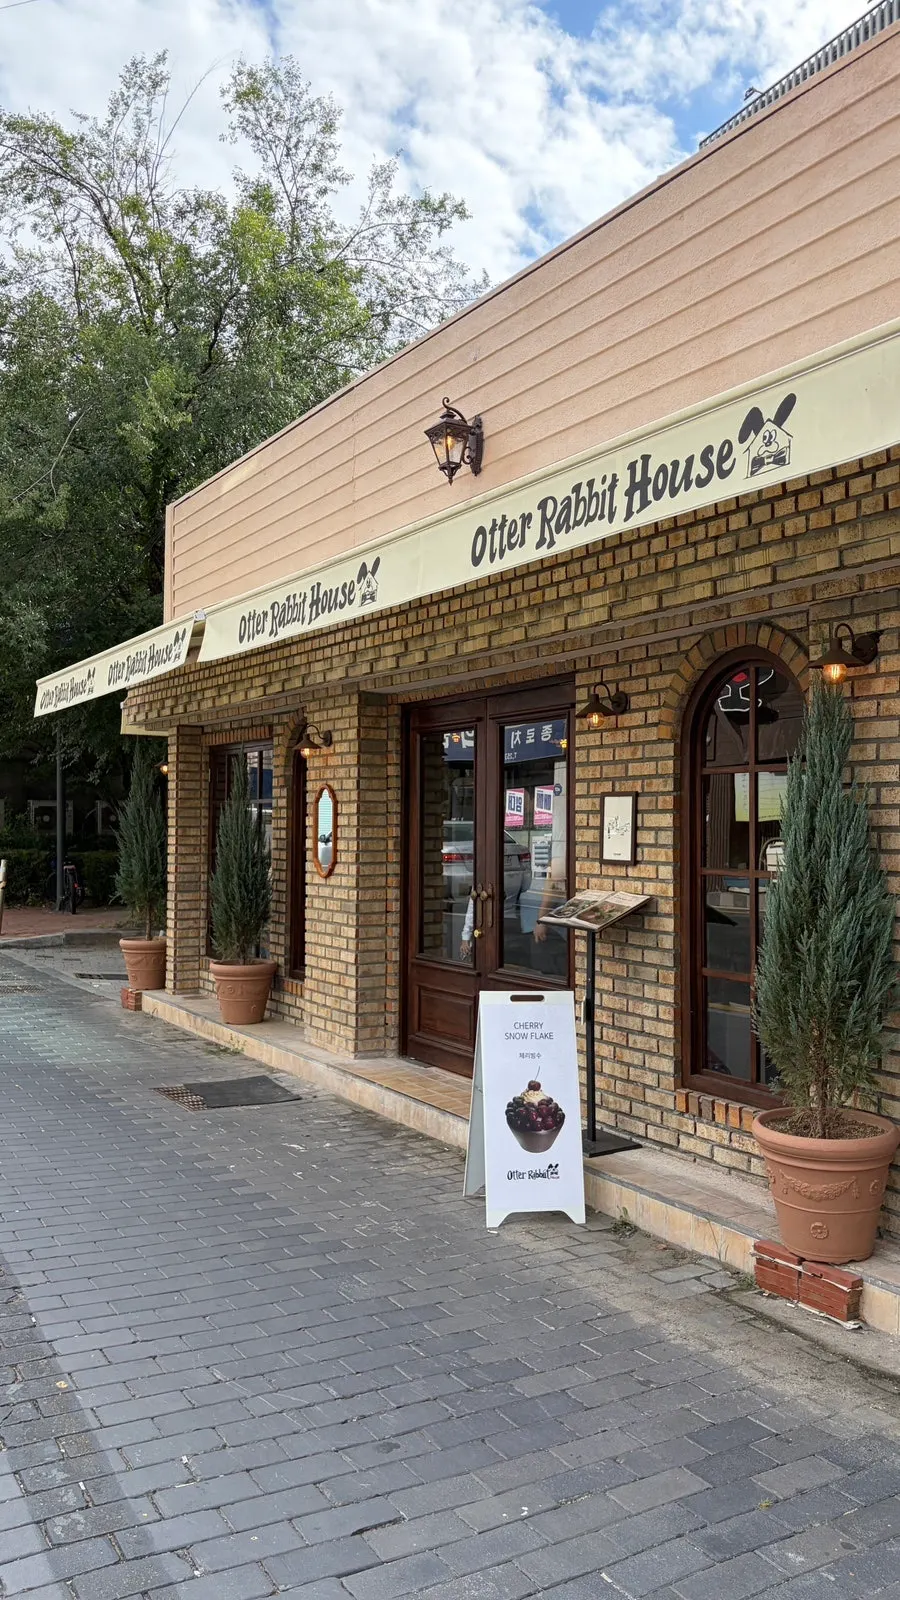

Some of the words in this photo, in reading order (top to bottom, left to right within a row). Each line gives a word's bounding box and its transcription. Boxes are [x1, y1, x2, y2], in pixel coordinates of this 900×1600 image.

[471, 512, 533, 567] Otter
[535, 473, 620, 549] Rabbit
[624, 439, 737, 522] House
[238, 609, 268, 644] Otter
[268, 592, 307, 638] Rabbit
[308, 580, 356, 625] House
[108, 660, 126, 687] Otter
[125, 650, 148, 683] Rabbit
[147, 643, 174, 675] House
[53, 682, 69, 708] Rabbit
[69, 677, 87, 703] House
[505, 1032, 529, 1040] SNOW
[530, 1031, 554, 1040] FLAKE
[513, 1021, 544, 1030] CHERRY
[507, 1169, 527, 1180] Otter
[528, 1168, 551, 1180] Rabbit
